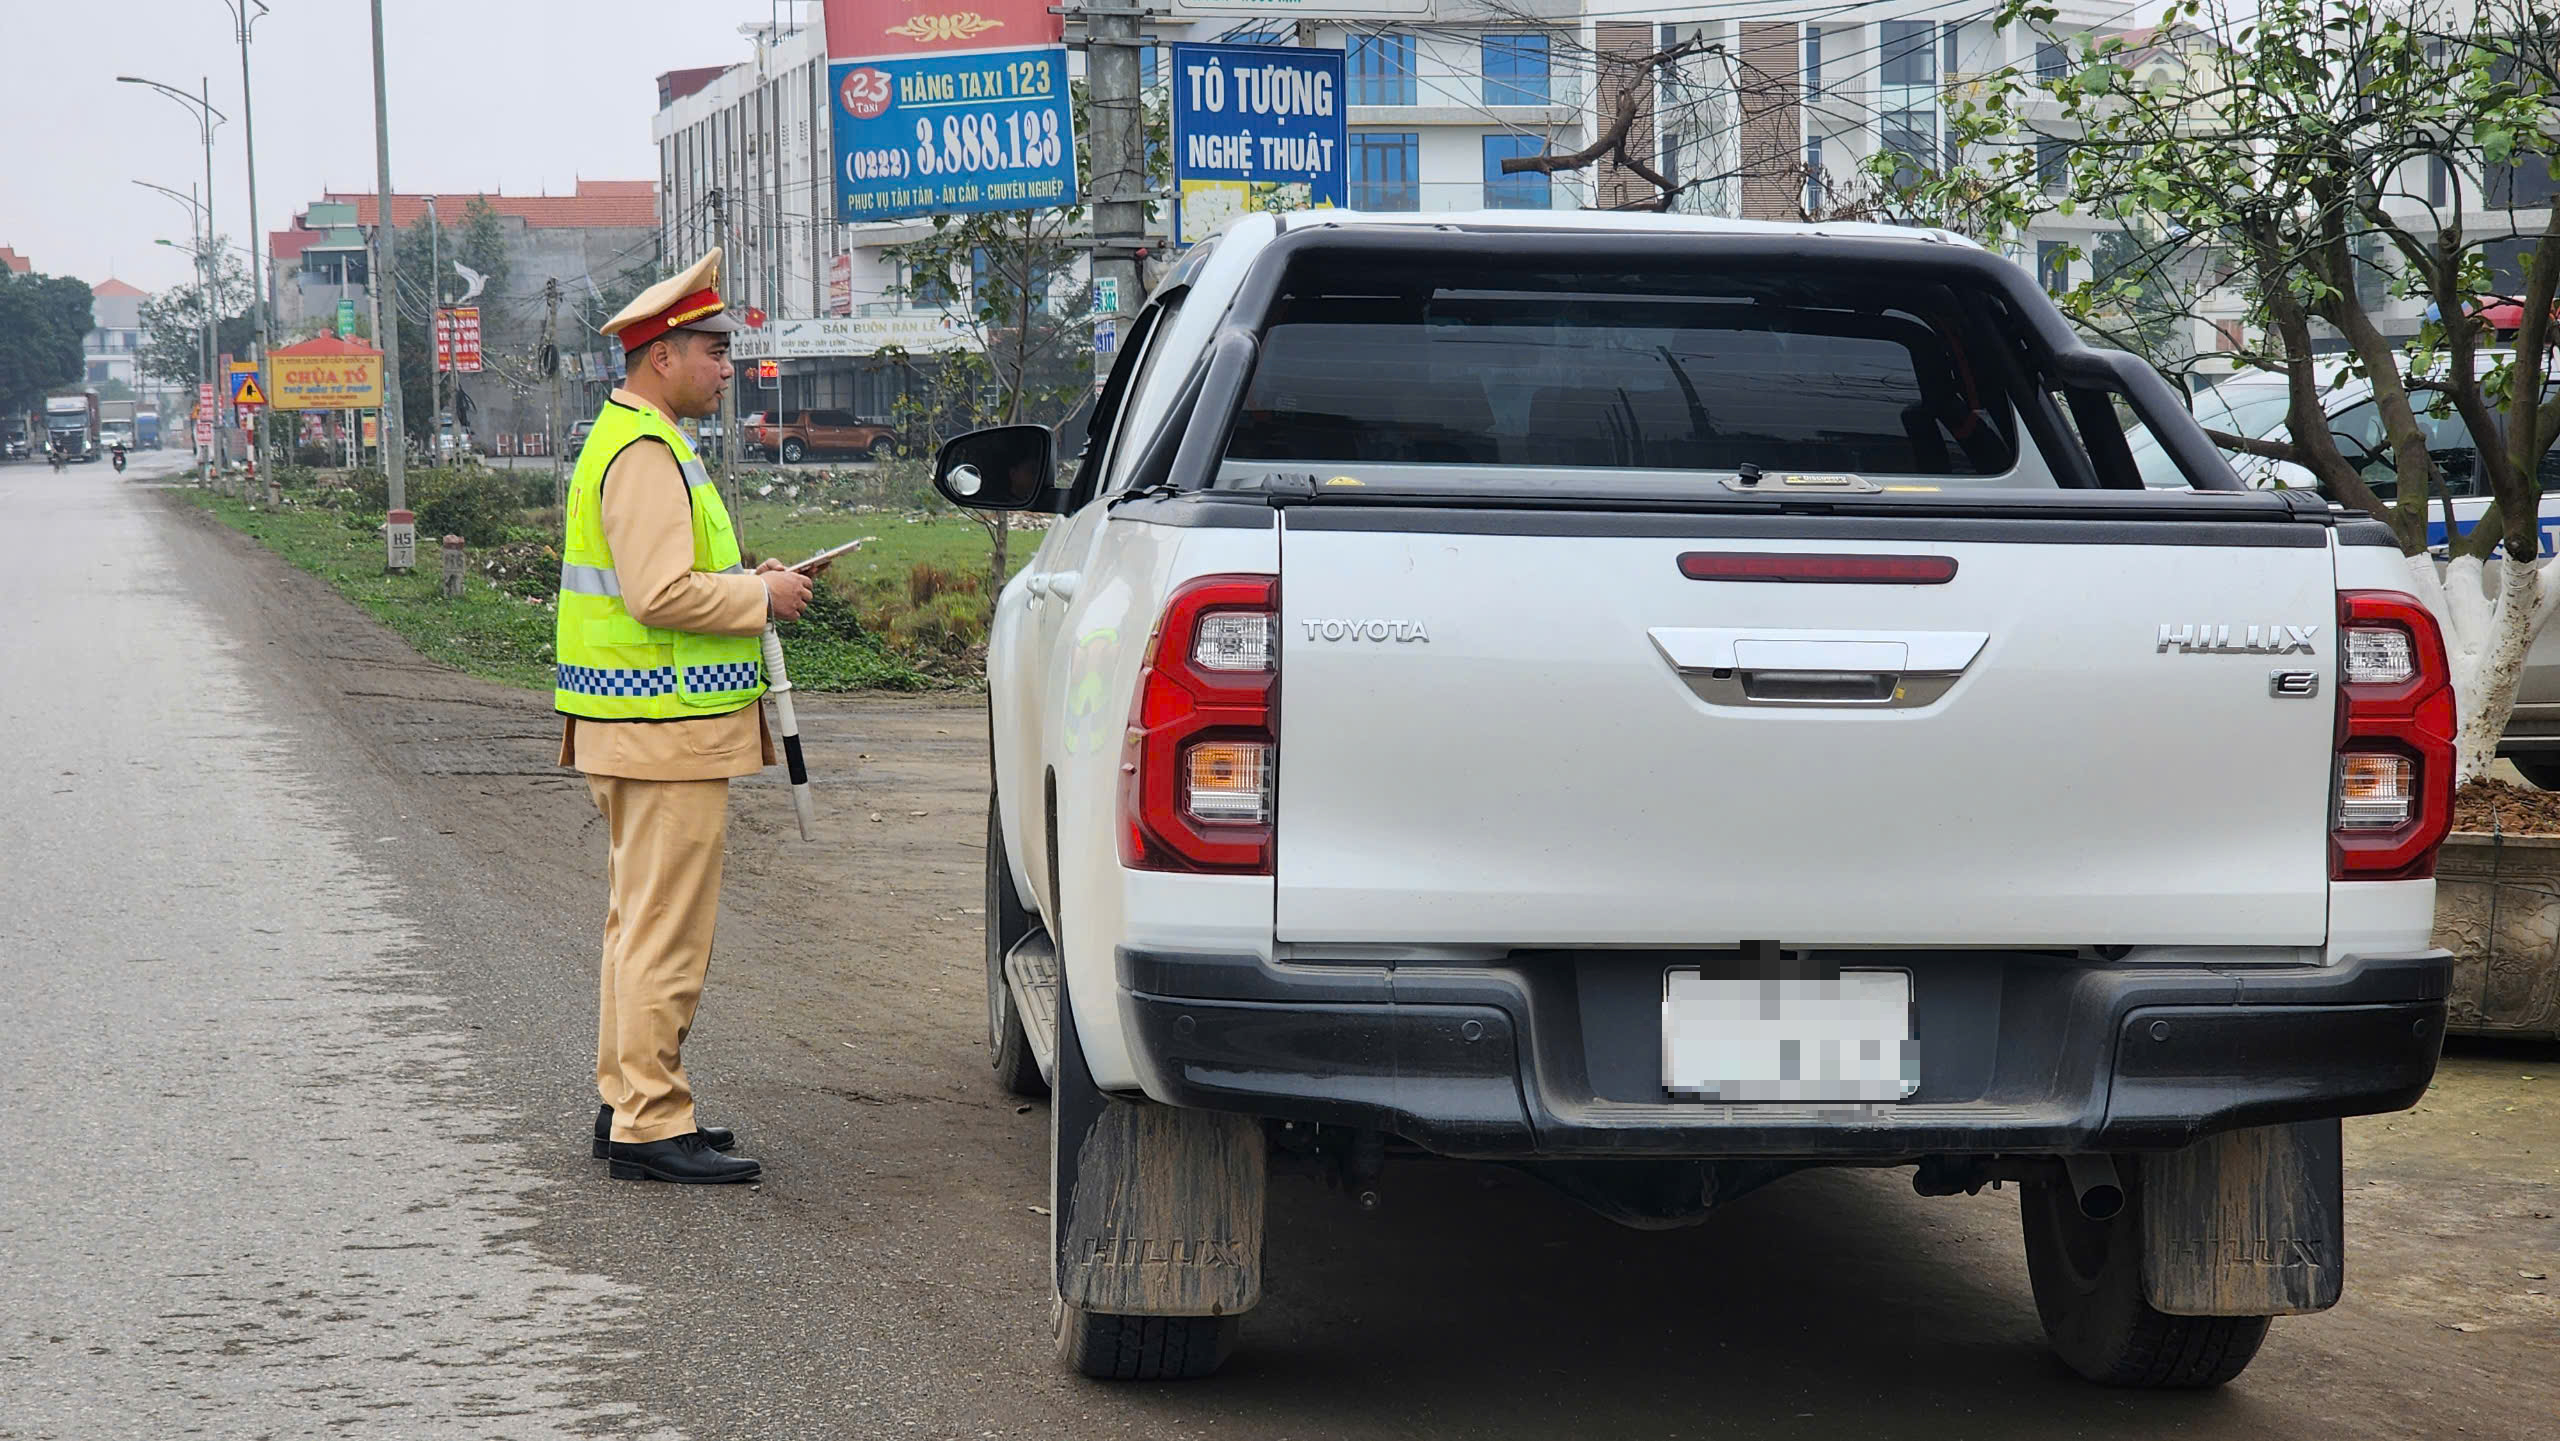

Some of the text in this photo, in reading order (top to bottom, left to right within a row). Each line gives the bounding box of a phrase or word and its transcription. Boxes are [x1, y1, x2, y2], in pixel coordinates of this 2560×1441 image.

[900, 60, 1051, 102] HÃNG TAXI 123
[1187, 56, 1333, 126] TÔ TƯỢNG
[845, 108, 1062, 184] (0222) 3.888.123
[1188, 129, 1334, 179] NGHỆ THUẬT
[848, 192, 874, 213] PHỤC
[876, 191, 889, 211] VỤ
[891, 187, 910, 210] TẬN
[912, 185, 934, 207] TÂM
[942, 184, 956, 203] ÂN
[987, 179, 1026, 201] CHUYÊN
[1028, 177, 1064, 201] NGHIỆP
[823, 321, 848, 334] BÁN
[853, 320, 887, 333] BUÔN
[285, 367, 339, 384] CHÙA
[393, 532, 412, 545] H5
[1302, 618, 1430, 643] TOYOTA
[2156, 623, 2319, 655] HILUX
[2274, 671, 2317, 696] E
[1081, 1235, 1242, 1267] HILUX
[2169, 1238, 2322, 1269] HILUX
